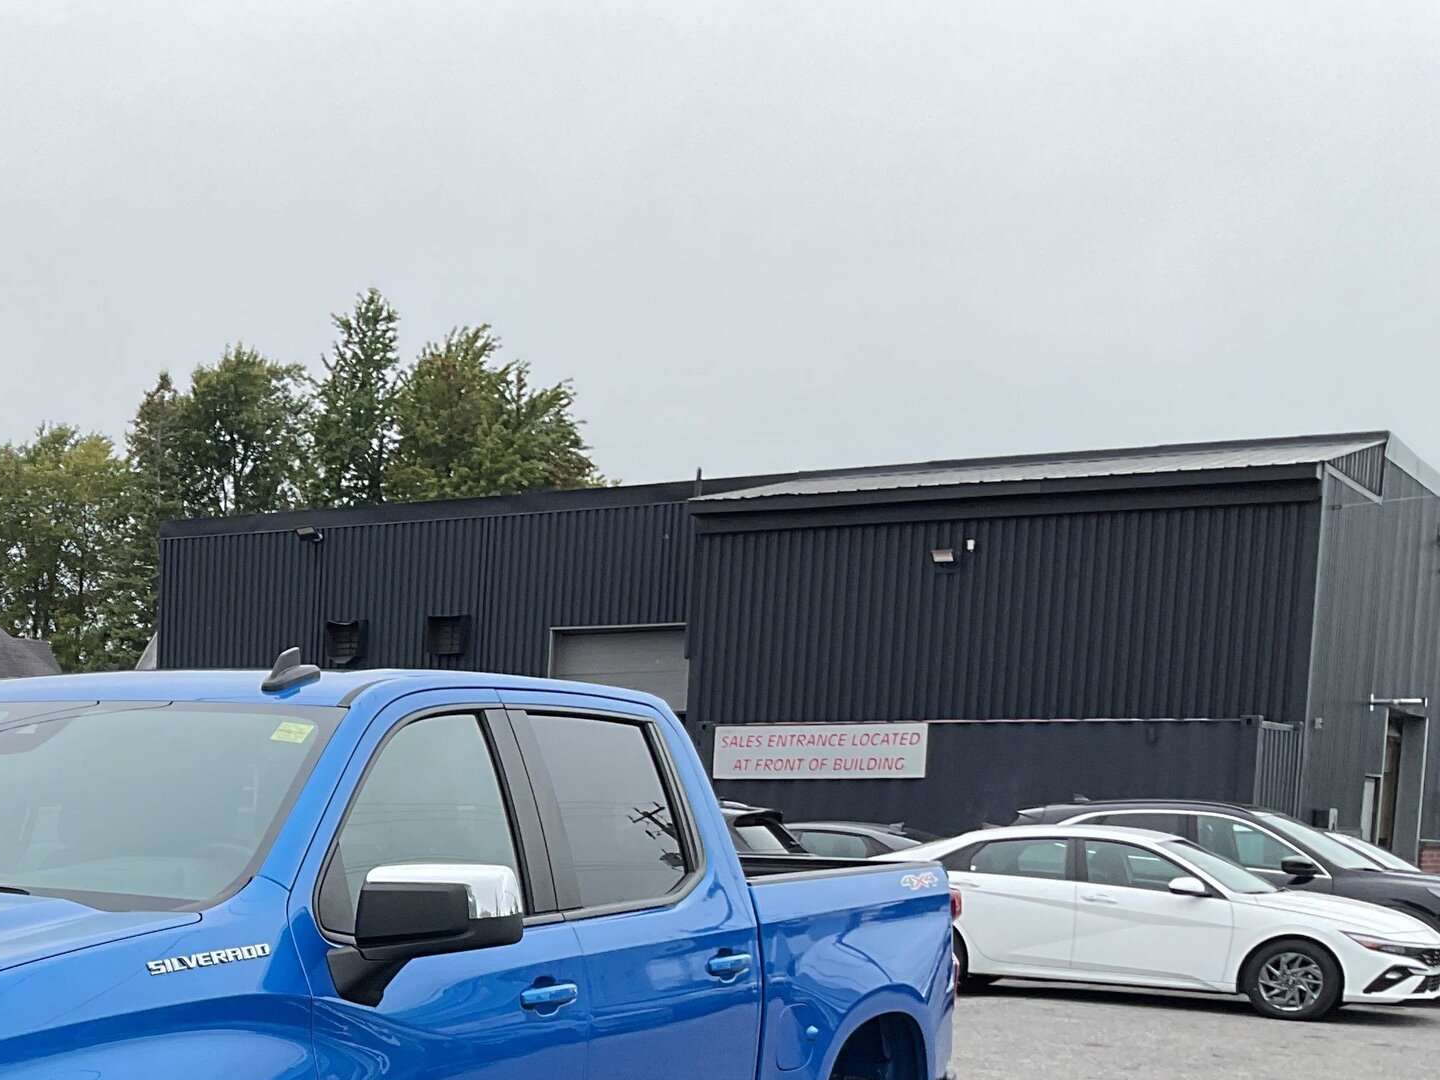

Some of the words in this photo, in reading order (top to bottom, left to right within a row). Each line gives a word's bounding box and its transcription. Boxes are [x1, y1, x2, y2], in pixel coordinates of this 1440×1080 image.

[721, 735, 762, 748] SALES
[767, 733, 847, 747] ENTRANCE
[851, 732, 921, 746] LOCATED
[732, 759, 751, 771] AT
[754, 758, 805, 771] FRONT
[809, 758, 829, 771] OF
[833, 757, 905, 771] BUILDING
[146, 943, 271, 975] SILVERADO
